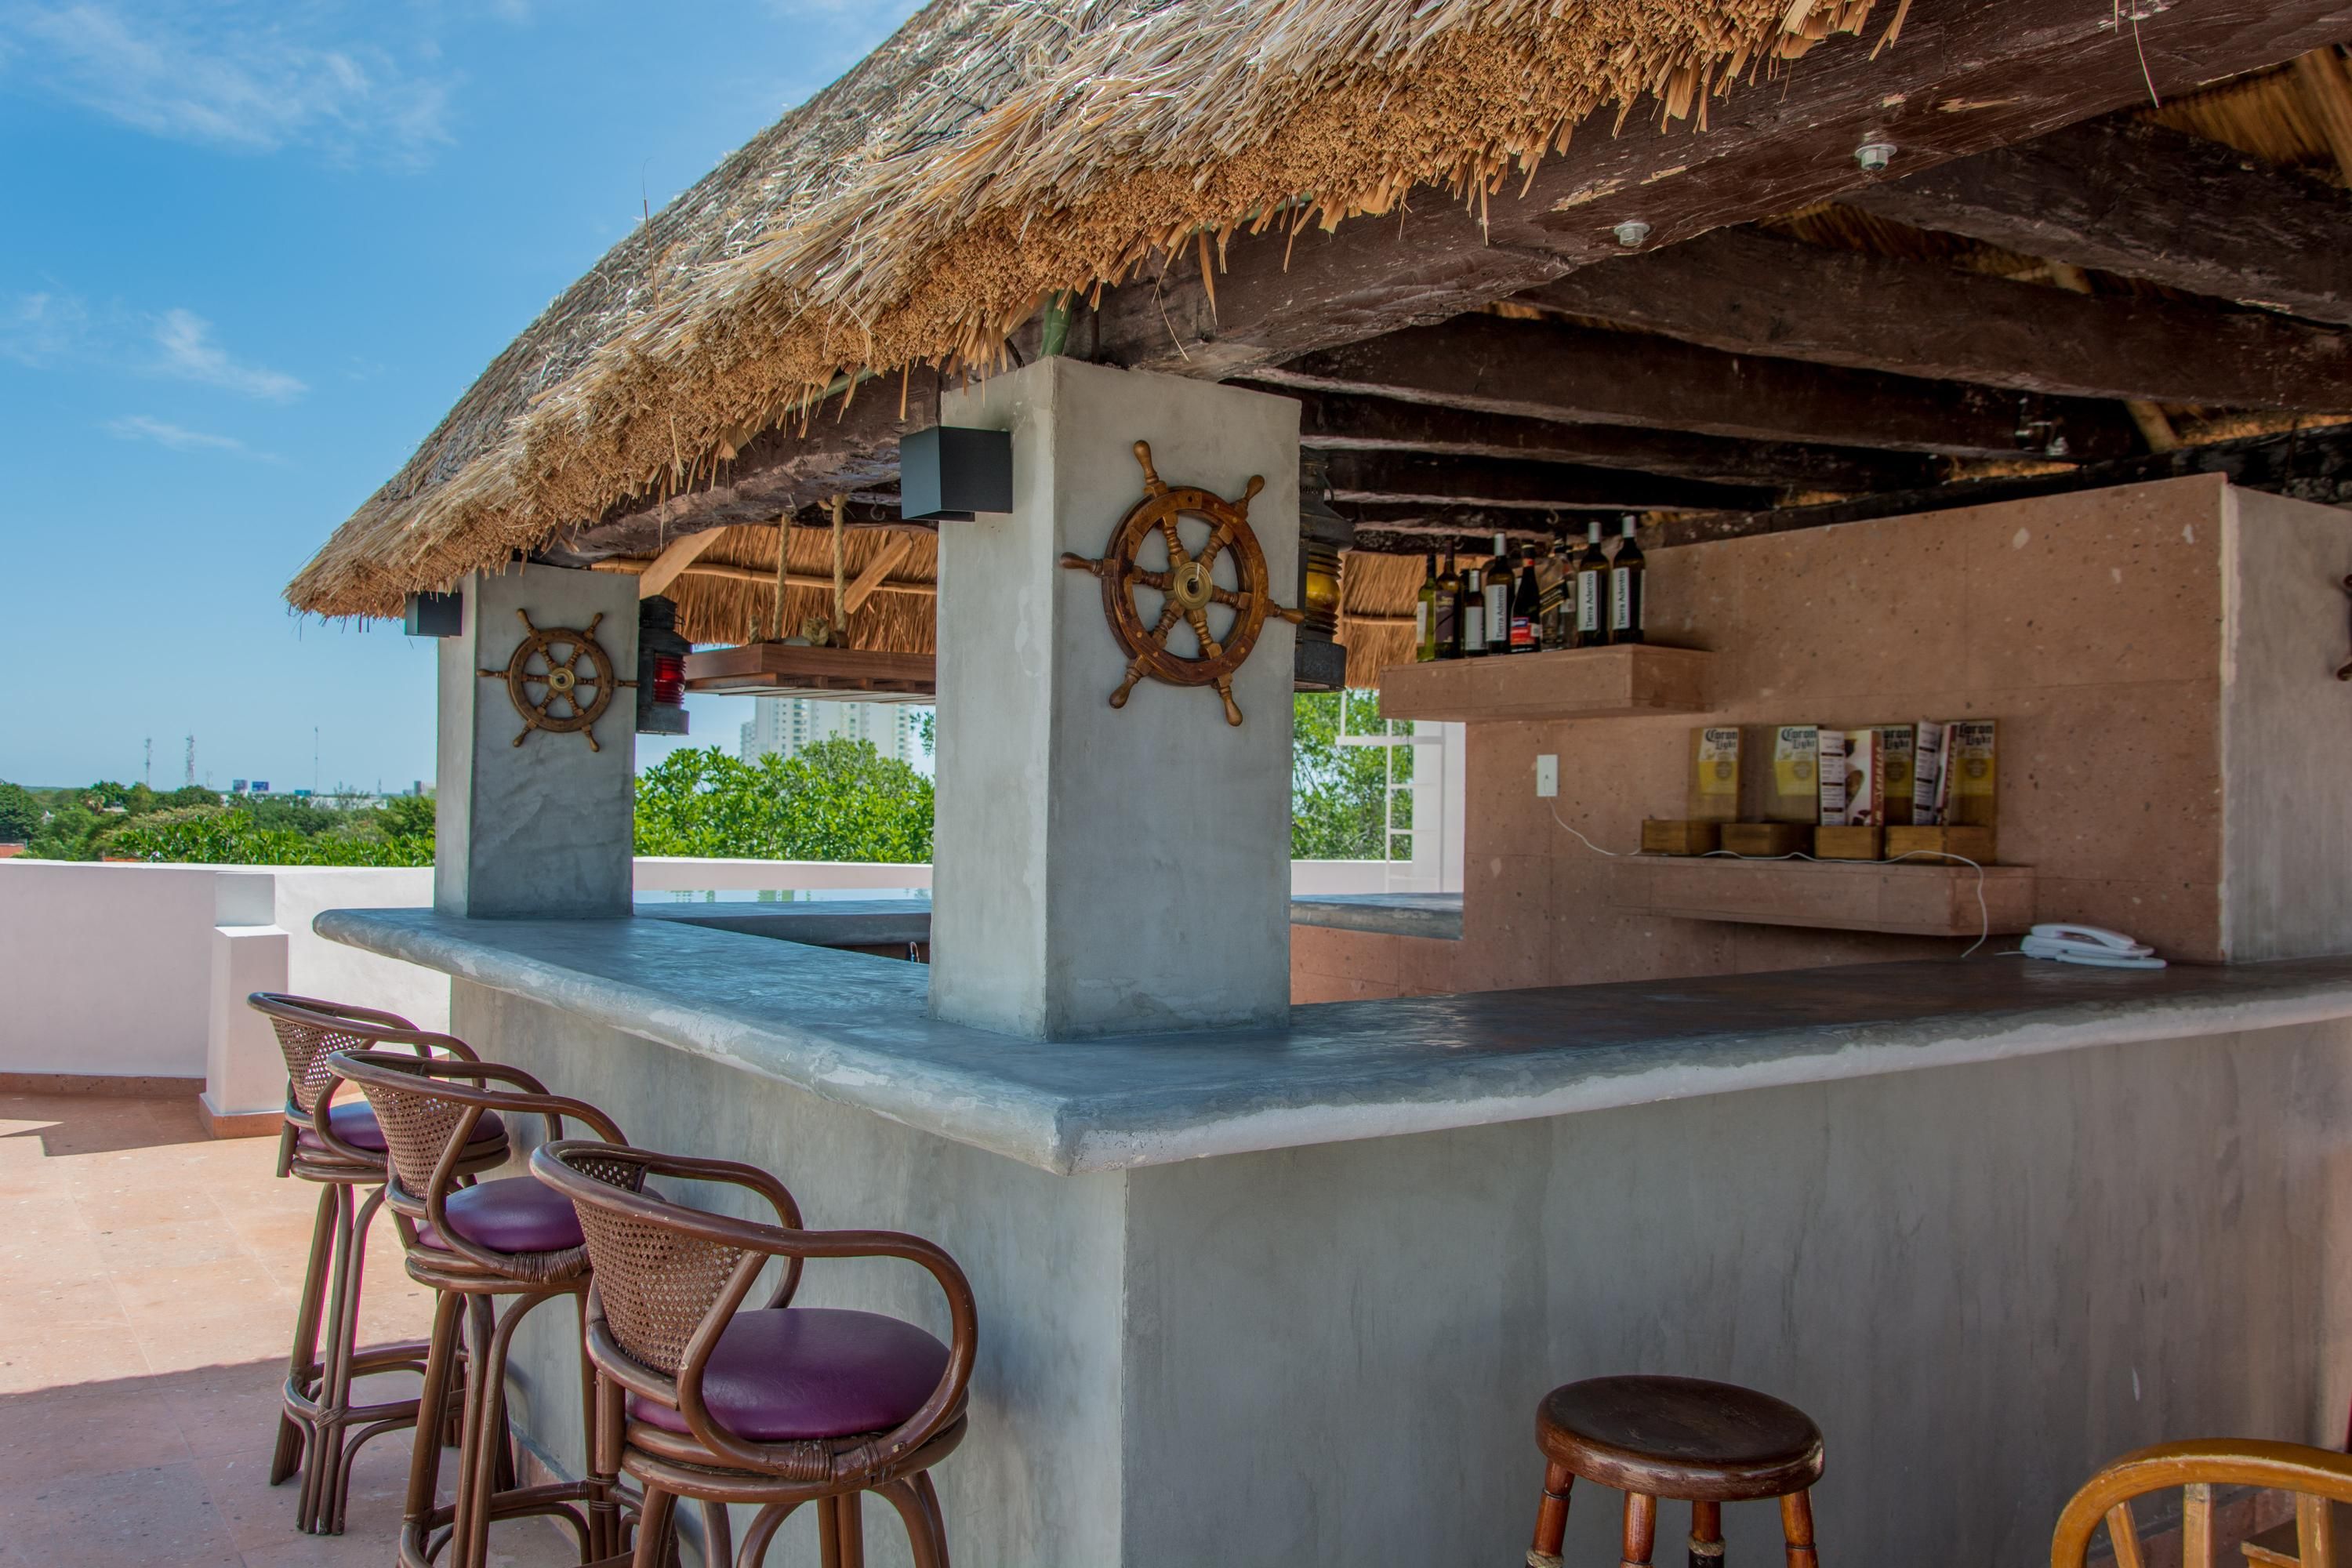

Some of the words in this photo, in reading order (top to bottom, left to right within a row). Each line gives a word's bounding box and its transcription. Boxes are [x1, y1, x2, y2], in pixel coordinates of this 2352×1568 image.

[1705, 729, 1737, 742] Coron
[1781, 728, 1817, 741] Coron
[1958, 723, 1993, 737] Coron
[1715, 740, 1736, 750] Light
[1793, 739, 1814, 749] Light
[1885, 738, 1908, 749] Light
[1966, 735, 1991, 745] Light
